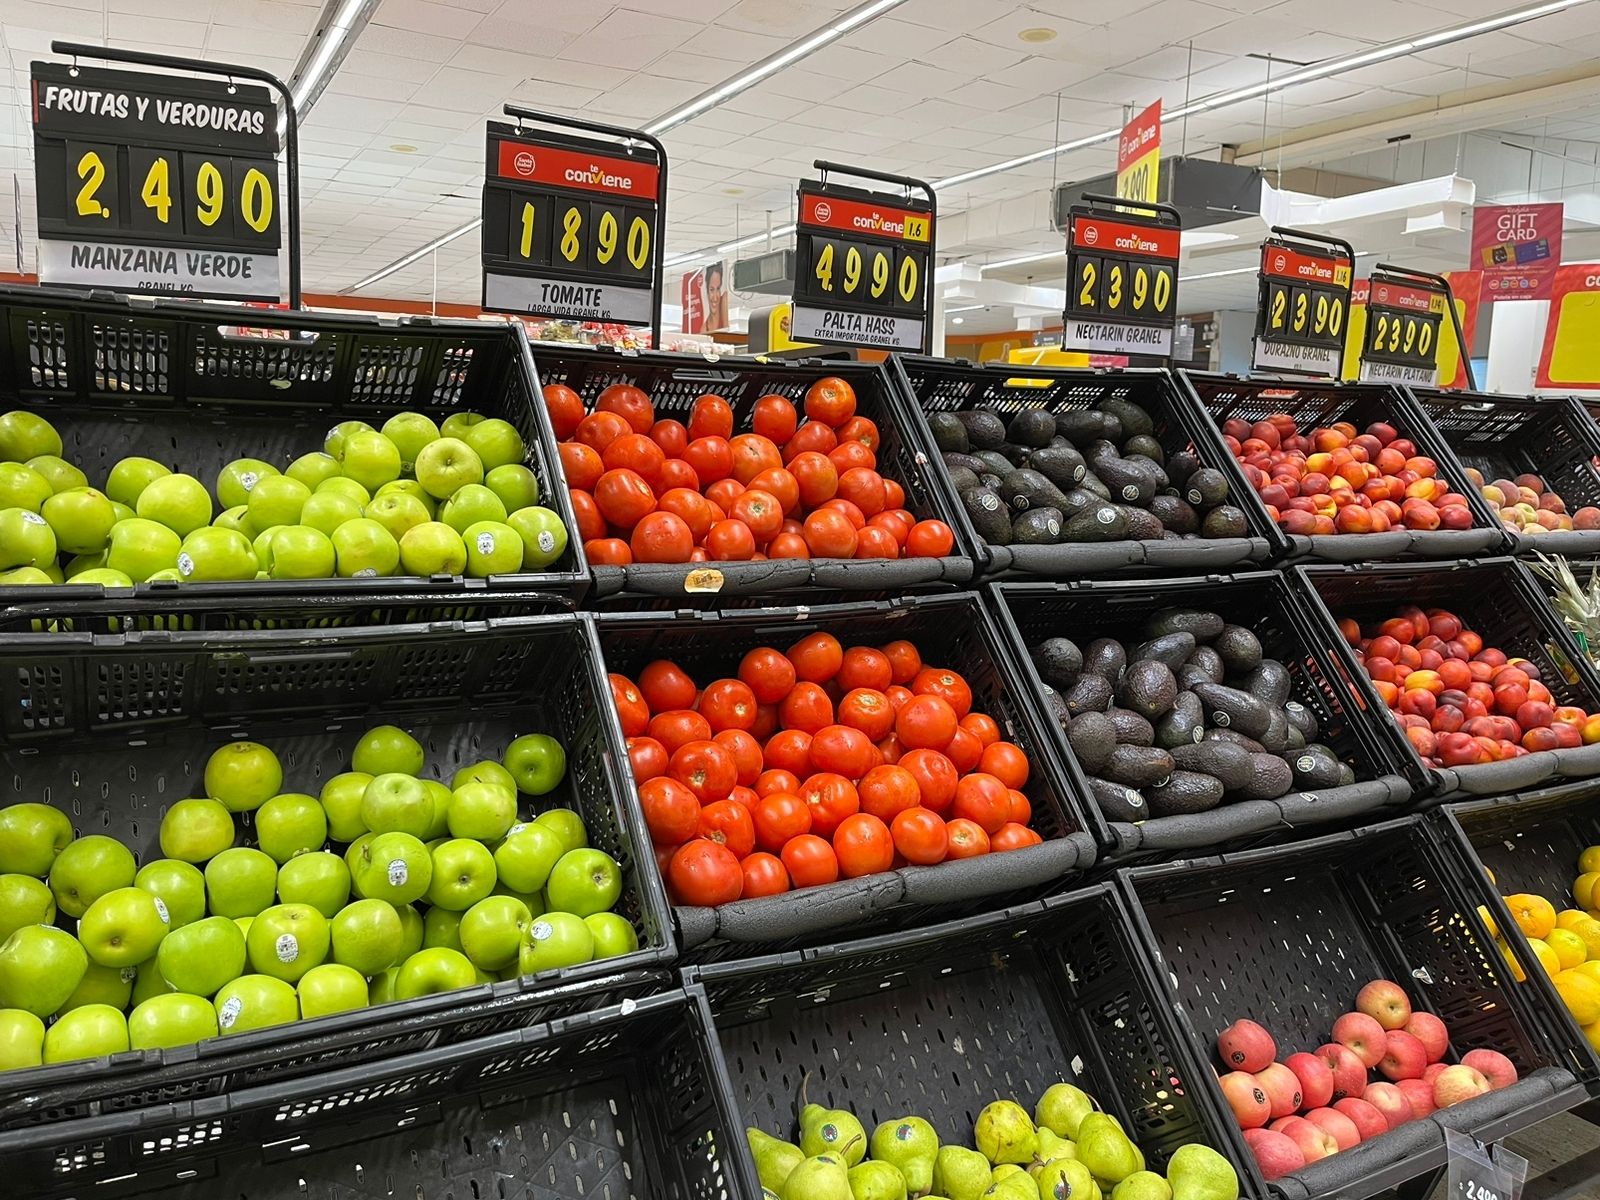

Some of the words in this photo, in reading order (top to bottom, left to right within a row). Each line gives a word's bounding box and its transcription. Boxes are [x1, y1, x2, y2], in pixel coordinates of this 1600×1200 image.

[45, 86, 129, 119] FRUTAS
[136, 96, 149, 121] Y
[156, 100, 264, 135] VERDURAS
[590, 164, 598, 173] te
[565, 169, 632, 189] conviene
[853, 216, 904, 233] conviene
[909, 222, 921, 237] 1.6
[1497, 213, 1538, 229] GIFT
[1497, 228, 1537, 241] CARD
[1115, 238, 1158, 251] conviene
[71, 245, 178, 275] MANZANA
[186, 253, 252, 279] VERDE
[1298, 265, 1332, 278] conviene
[816, 243, 918, 302] 4.990
[541, 283, 602, 307] TOMATE
[1080, 262, 1170, 312] 2.390
[528, 304, 551, 313] LARGA
[554, 306, 571, 315] VIDA
[573, 308, 599, 318] GRANEL
[823, 312, 861, 331] PALTA
[865, 317, 895, 335] HASS
[814, 329, 834, 339] EXTRA
[835, 331, 868, 343] IMPORTADA
[870, 335, 890, 345] GRANEL
[1076, 324, 1124, 341] NECTARIN
[1126, 328, 1162, 344] GRANEL
[1264, 342, 1300, 359] DURAZNO
[1302, 347, 1330, 361] GRANEL
[1369, 362, 1402, 379] NECTARIN
[1403, 366, 1433, 383] PLATANO
